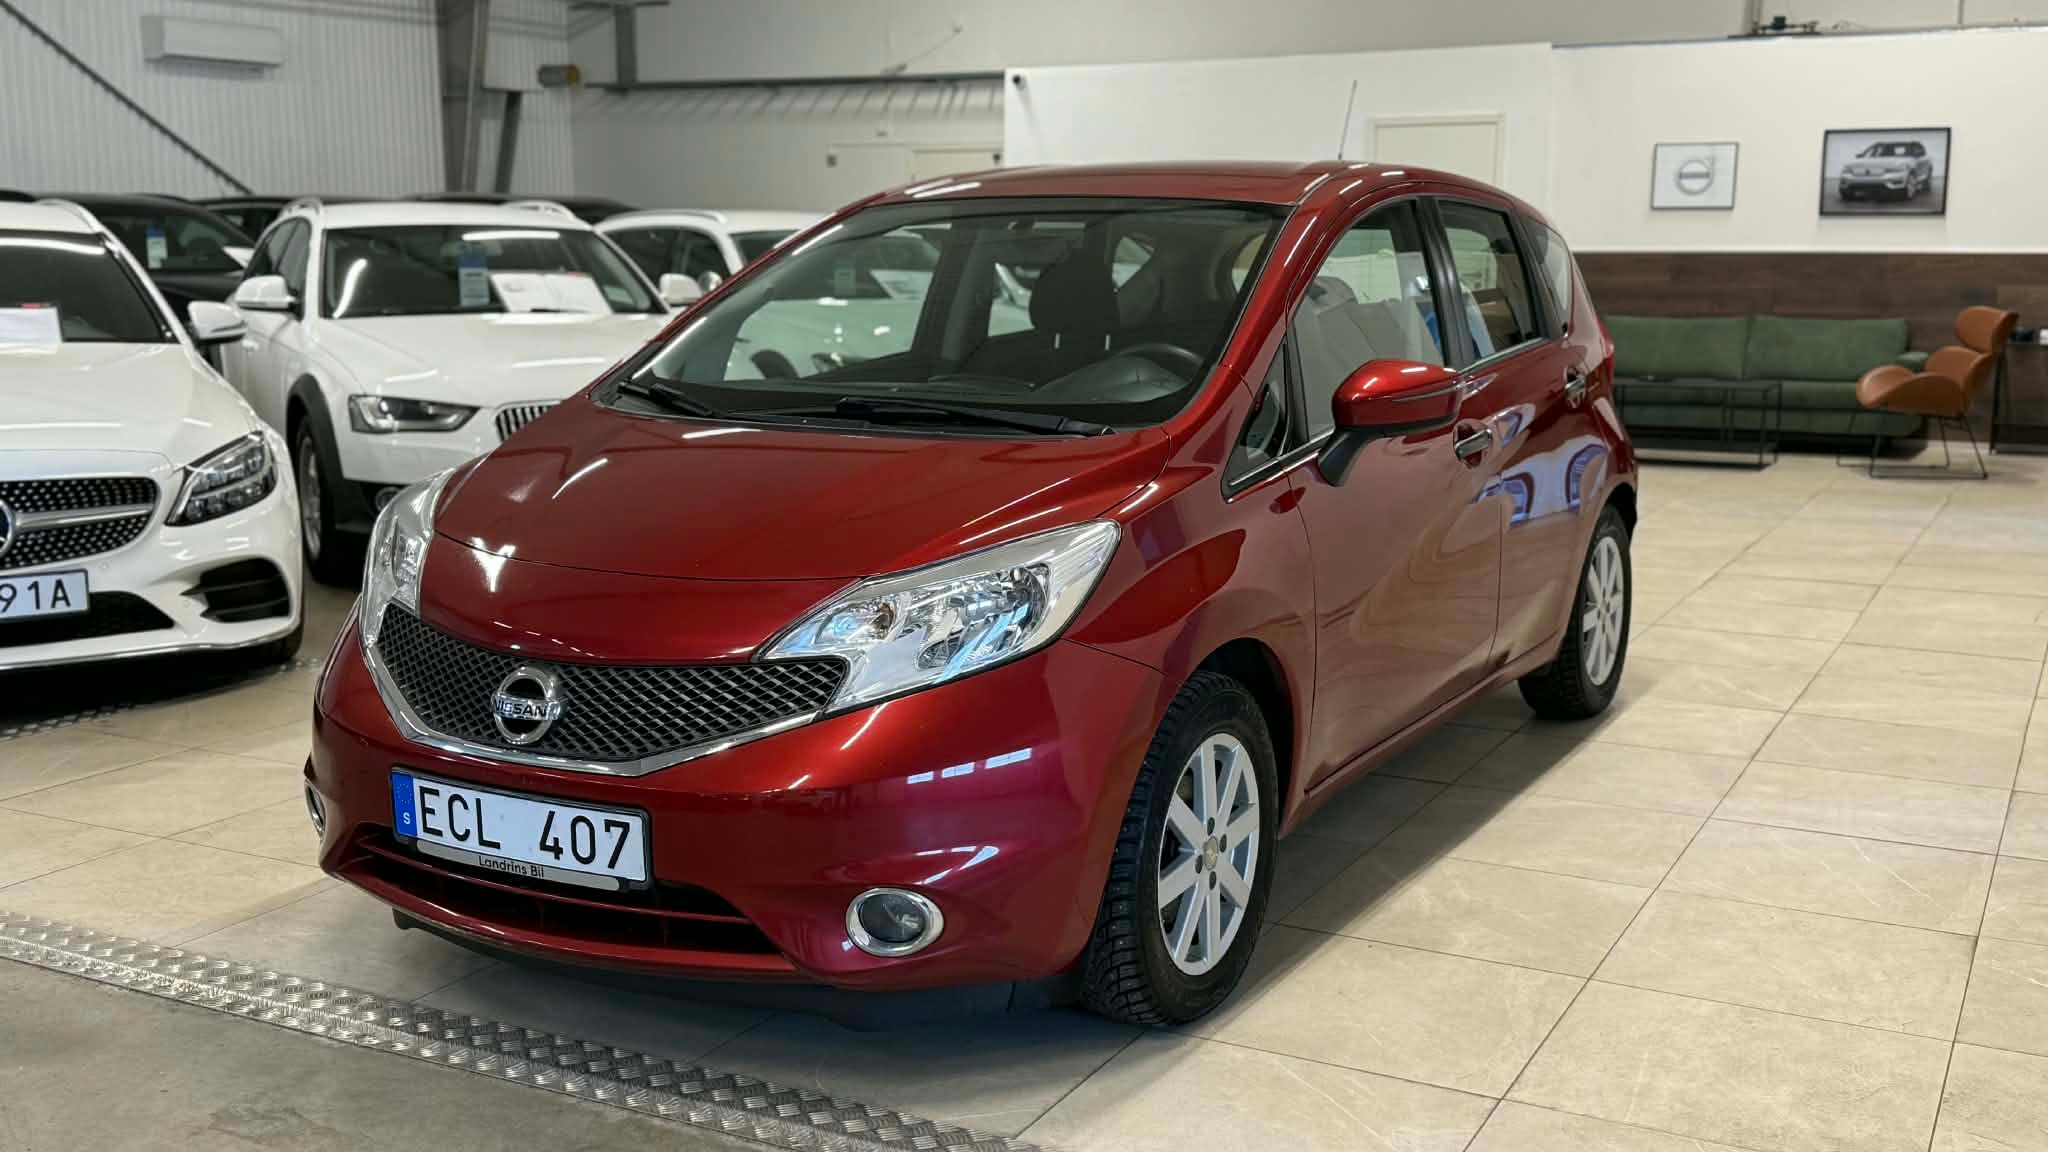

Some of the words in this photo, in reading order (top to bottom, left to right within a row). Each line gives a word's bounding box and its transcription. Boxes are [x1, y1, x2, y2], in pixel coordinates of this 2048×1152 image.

[495, 697, 547, 717] NISSAN
[403, 812, 411, 825] S
[419, 785, 501, 849] ECL
[539, 810, 630, 869] 407
[479, 855, 527, 875] Landrins
[530, 864, 545, 878] Bil
